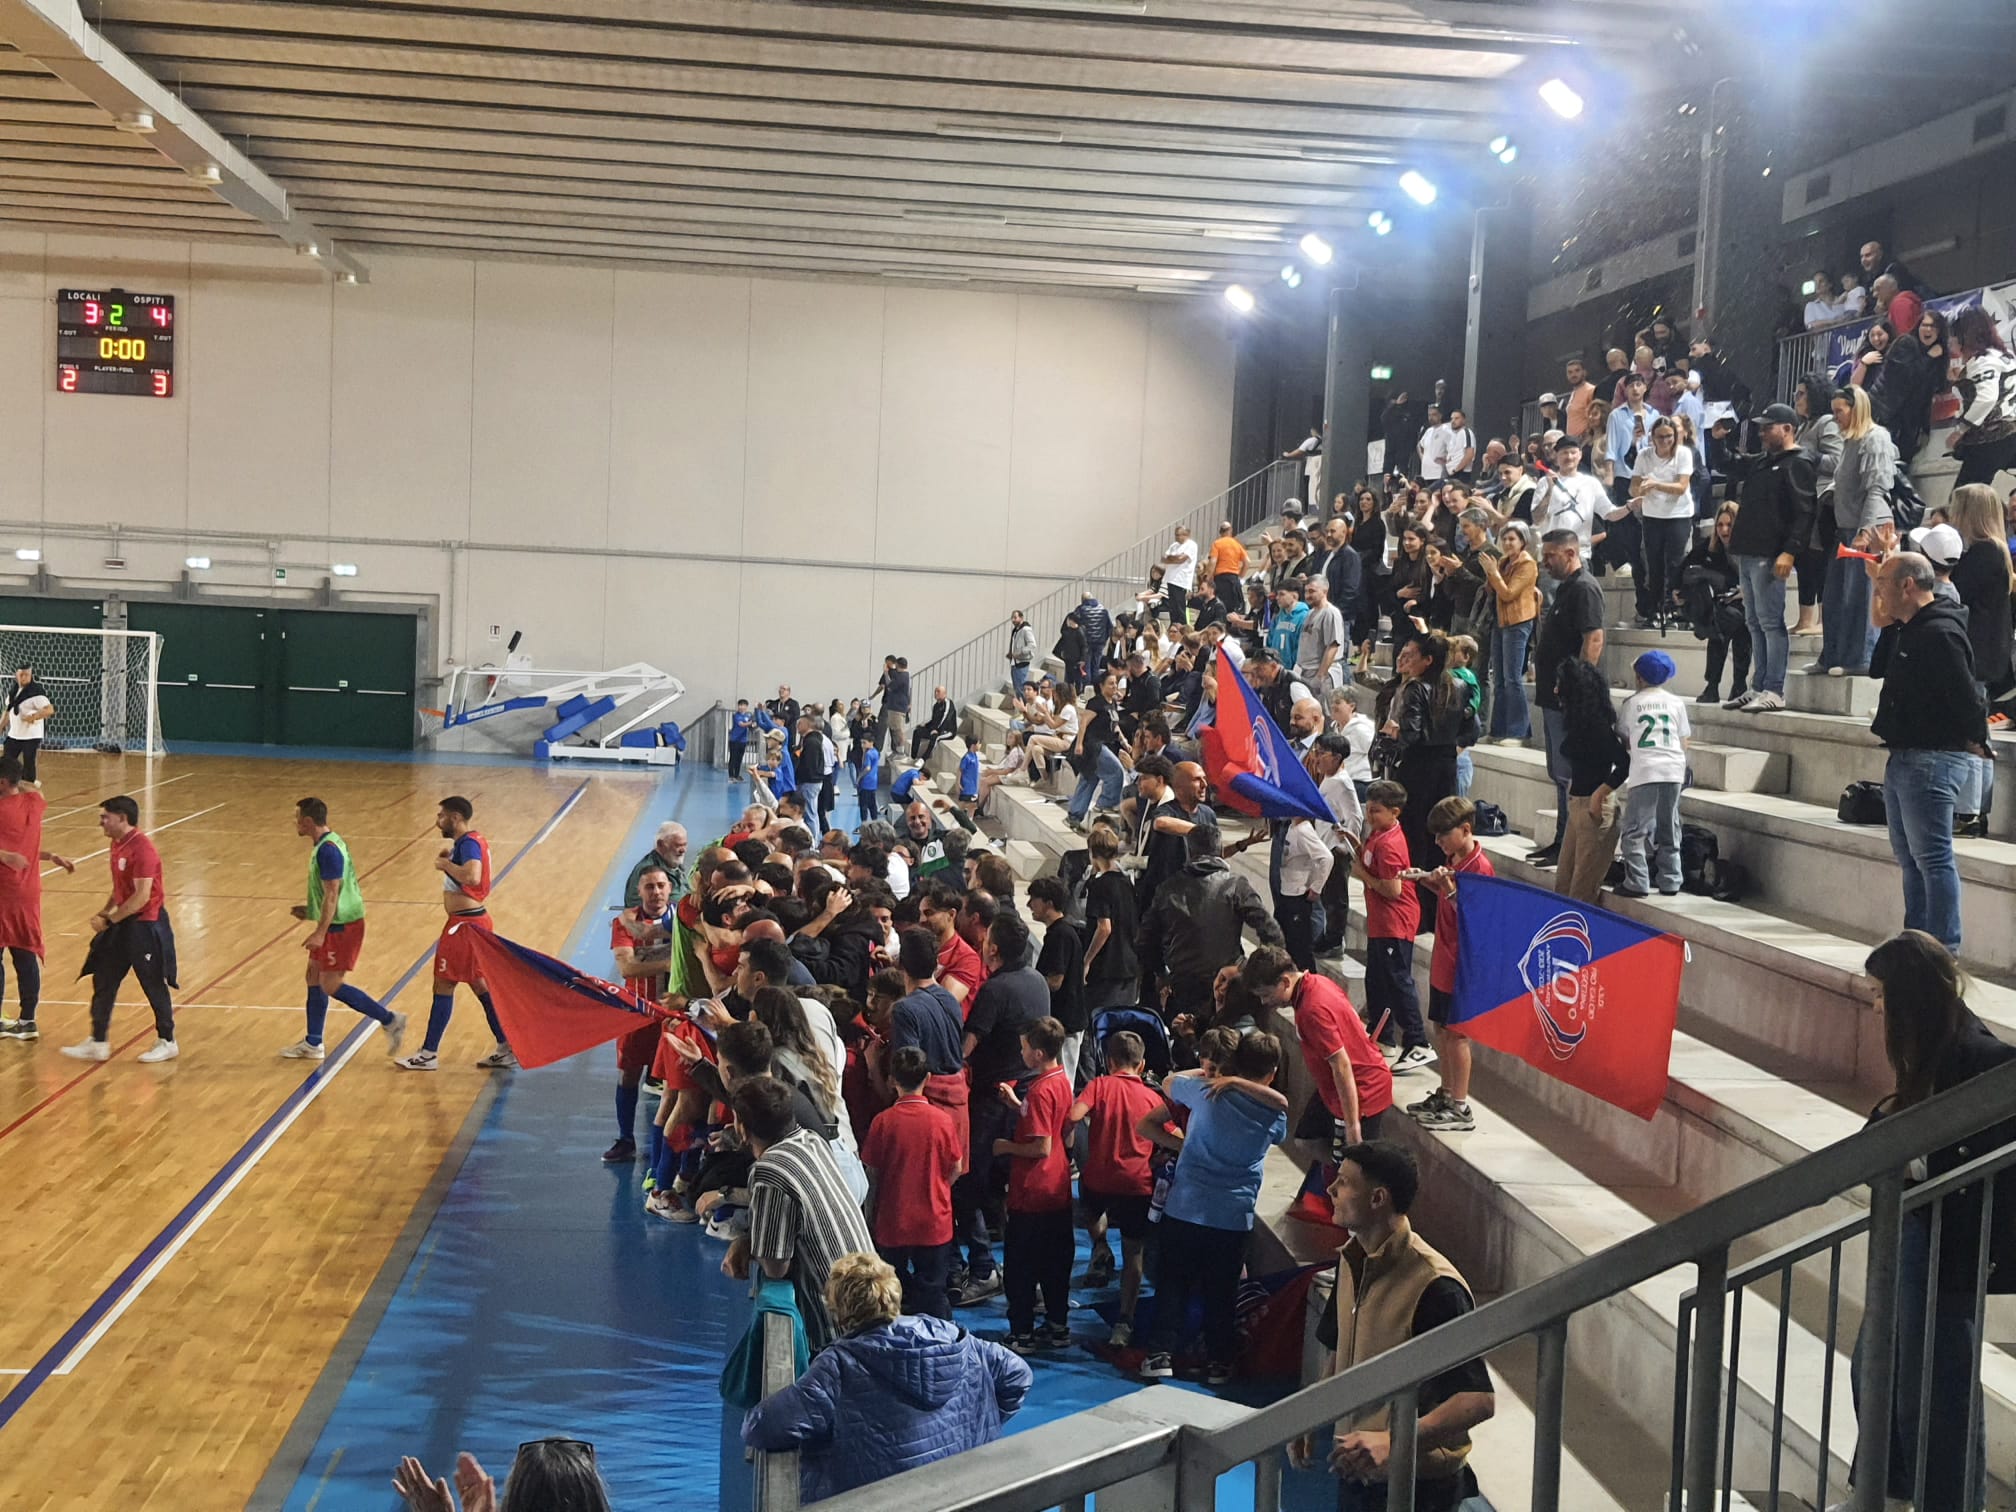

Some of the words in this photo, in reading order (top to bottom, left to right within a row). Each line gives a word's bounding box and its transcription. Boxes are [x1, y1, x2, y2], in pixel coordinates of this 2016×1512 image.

[67, 292, 101, 301] LOCALI
[133, 296, 165, 305] OSPITI
[85, 303, 98, 324] 3
[110, 304, 123, 325] 2
[152, 307, 166, 327] 4
[100, 337, 145, 361] 0:00
[62, 369, 76, 391] 2
[153, 375, 167, 396] 3
[1637, 714, 1670, 749] 21
[327, 951, 337, 966] 5
[438, 957, 448, 972] 3
